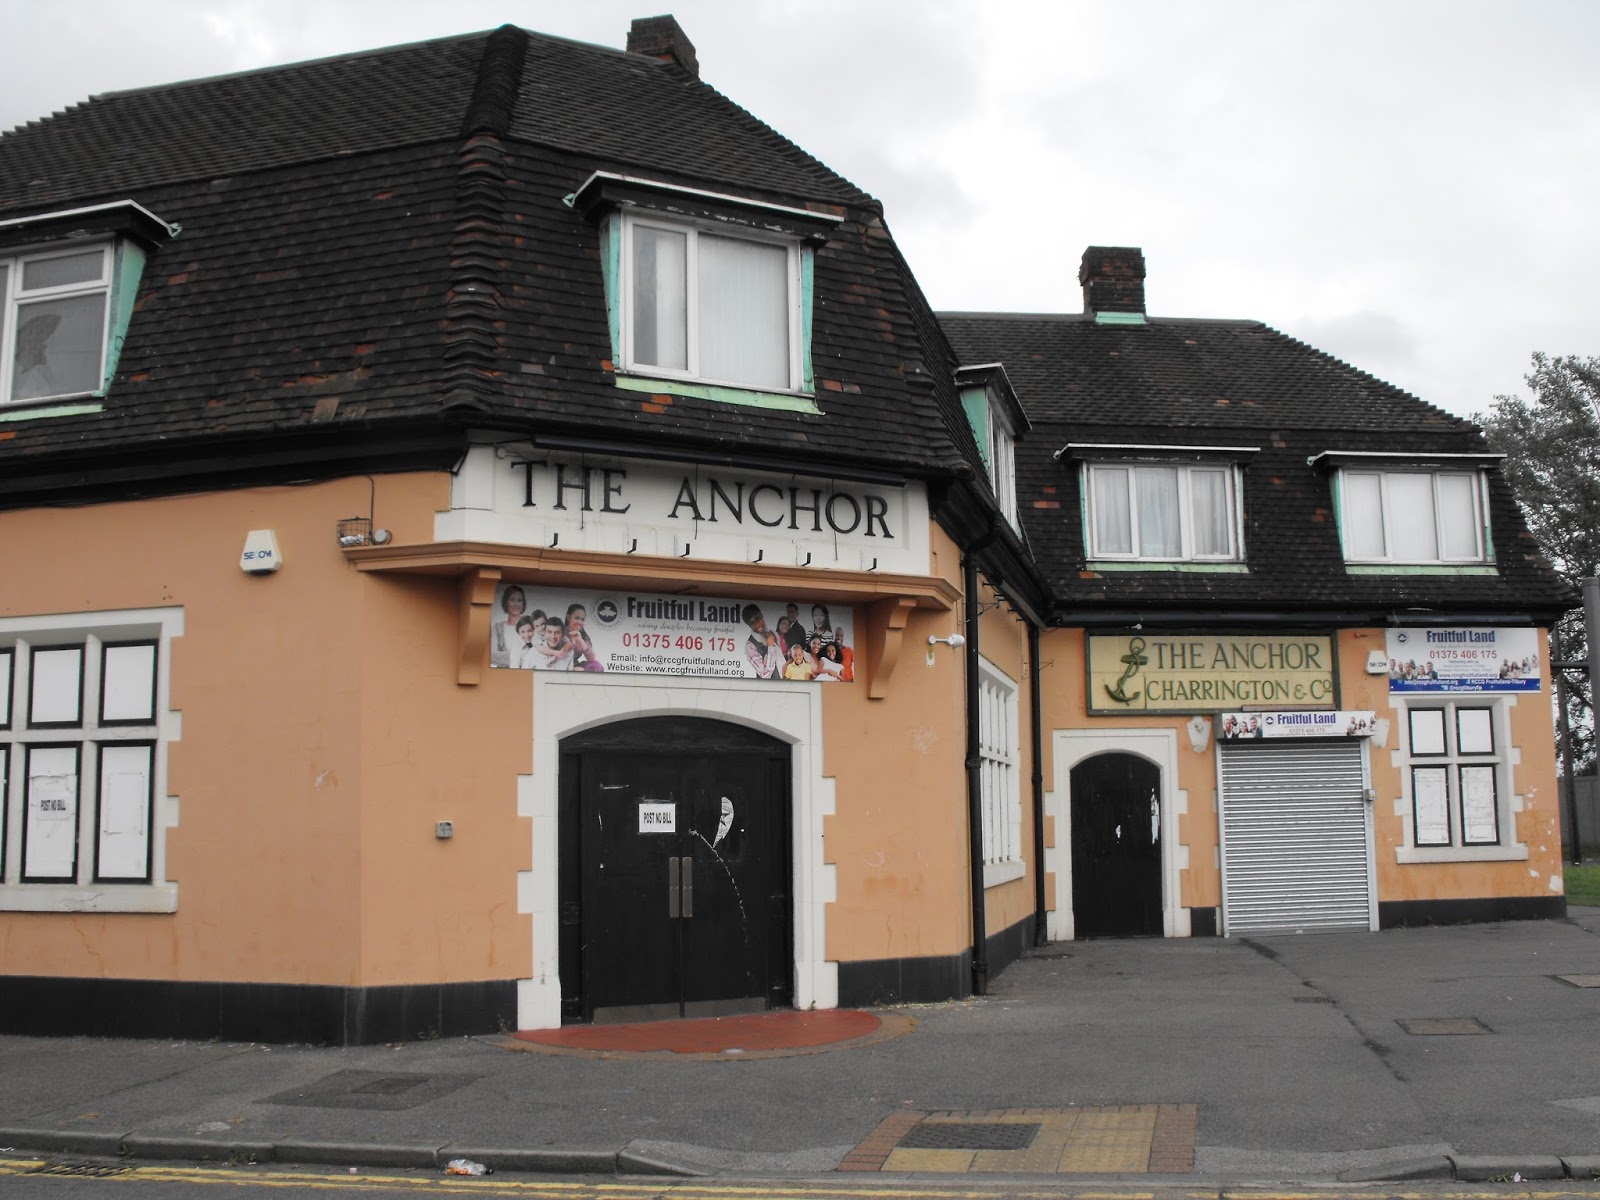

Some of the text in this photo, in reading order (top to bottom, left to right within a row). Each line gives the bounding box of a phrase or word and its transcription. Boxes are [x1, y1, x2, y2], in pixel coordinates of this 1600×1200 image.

[511, 461, 894, 539] THE ANCHOR
[627, 596, 695, 621] Fruitful
[699, 601, 741, 624] Land
[623, 632, 735, 652] 01375 406 175
[1427, 630, 1496, 643] Fruitful Land
[611, 653, 741, 668] Email: info@rccgfruitfulland.org
[1152, 642, 1322, 670] THE ANCHOR
[1430, 650, 1497, 659] 01375 406 175
[607, 662, 745, 677] Website: www.rccgfruitfulland.org
[1147, 680, 1289, 701] CHARRINGTON
[1294, 683, 1307, 700] &
[1277, 713, 1336, 725] Fruitful Land
[643, 812, 672, 824] POST NO BILL
